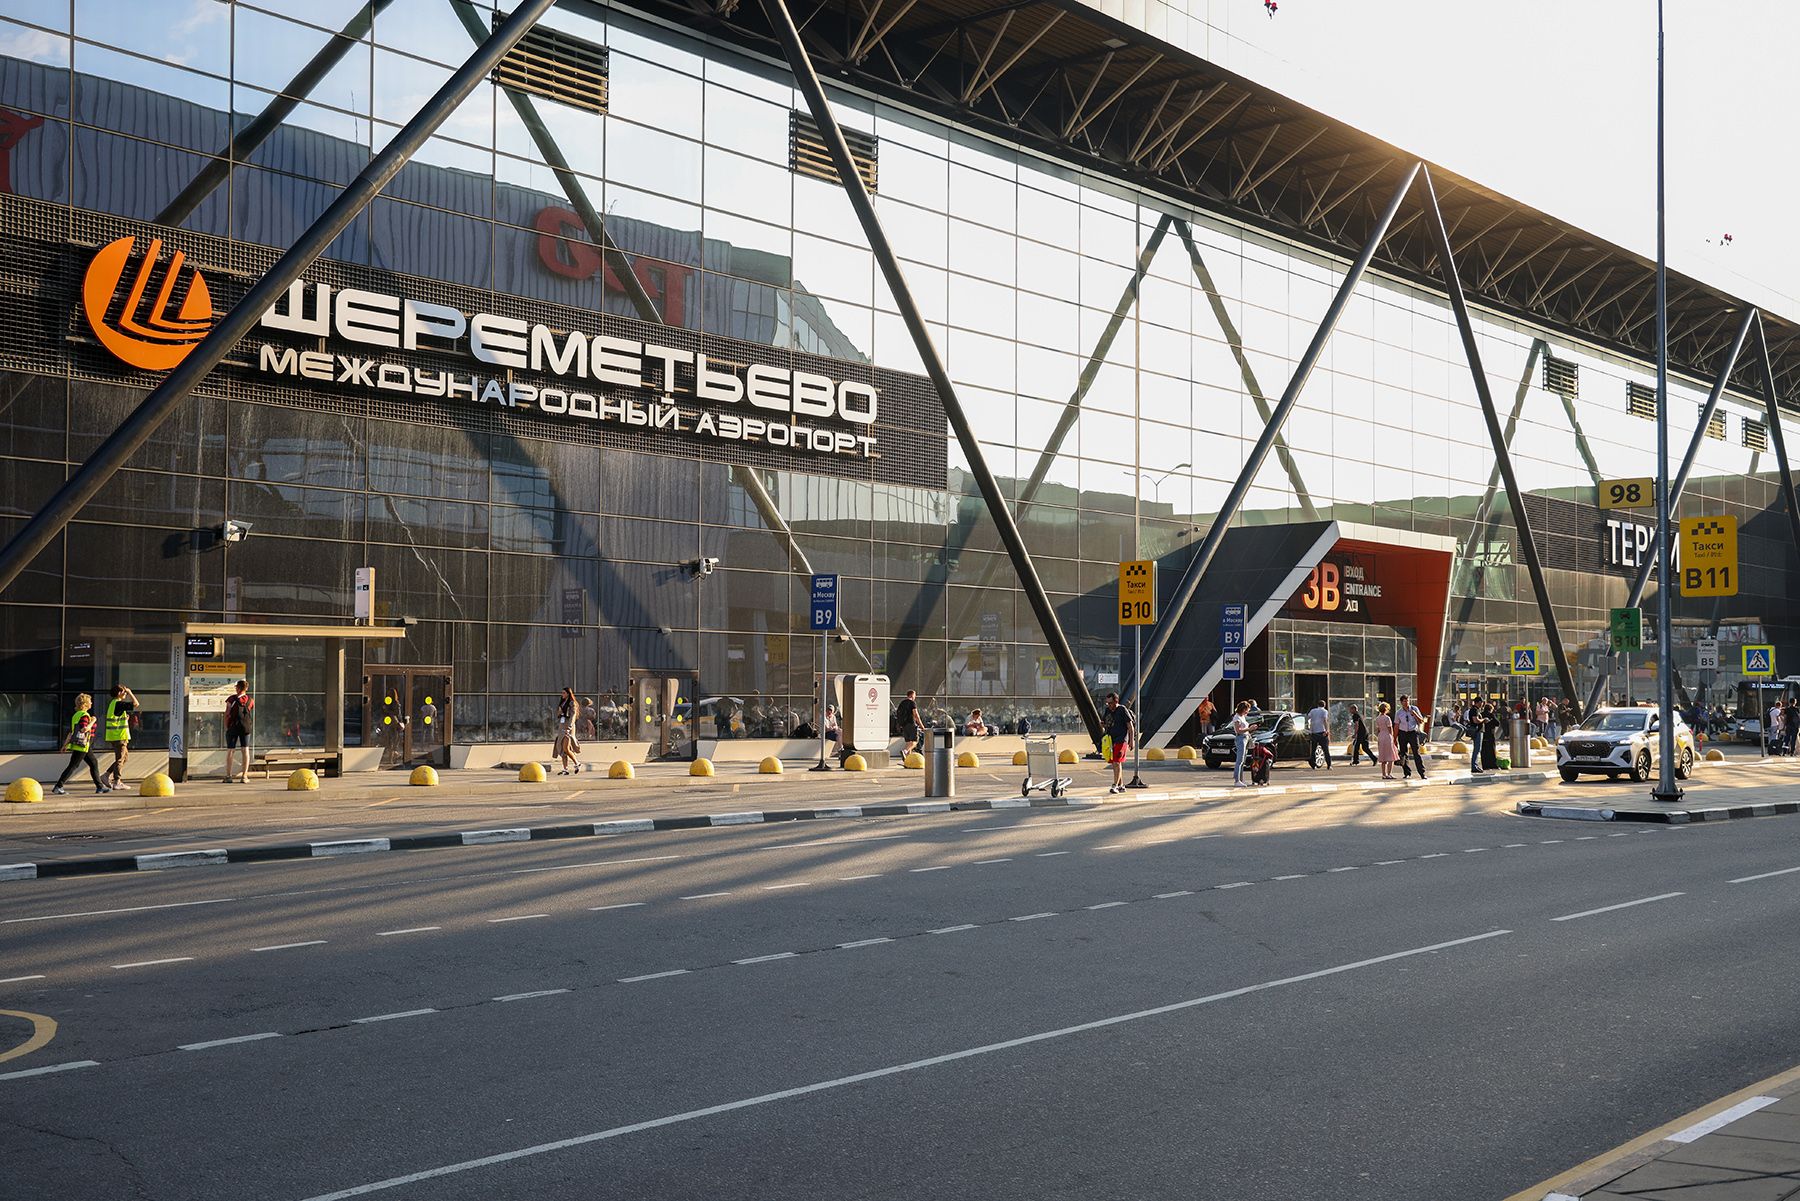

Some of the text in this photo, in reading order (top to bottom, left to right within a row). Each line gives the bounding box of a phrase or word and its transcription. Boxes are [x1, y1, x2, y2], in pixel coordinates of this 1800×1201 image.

[261, 272, 877, 424] ШЕРЕМЕТЬЕВО
[260, 344, 877, 458] МЕЖДУНАРОДНЫЙ АЭРОПОРТ
[1610, 483, 1641, 504] 98
[1692, 541, 1724, 551] Такси
[1344, 565, 1365, 581] ВХОД
[1686, 567, 1729, 589] B11
[1303, 562, 1340, 611] 3B
[1344, 583, 1382, 597] ENTRANCE
[1122, 601, 1151, 618] B10
[1344, 599, 1359, 612] 入口
[815, 609, 832, 624] B9
[1225, 631, 1241, 643] B9
[1701, 657, 1715, 666] B5
